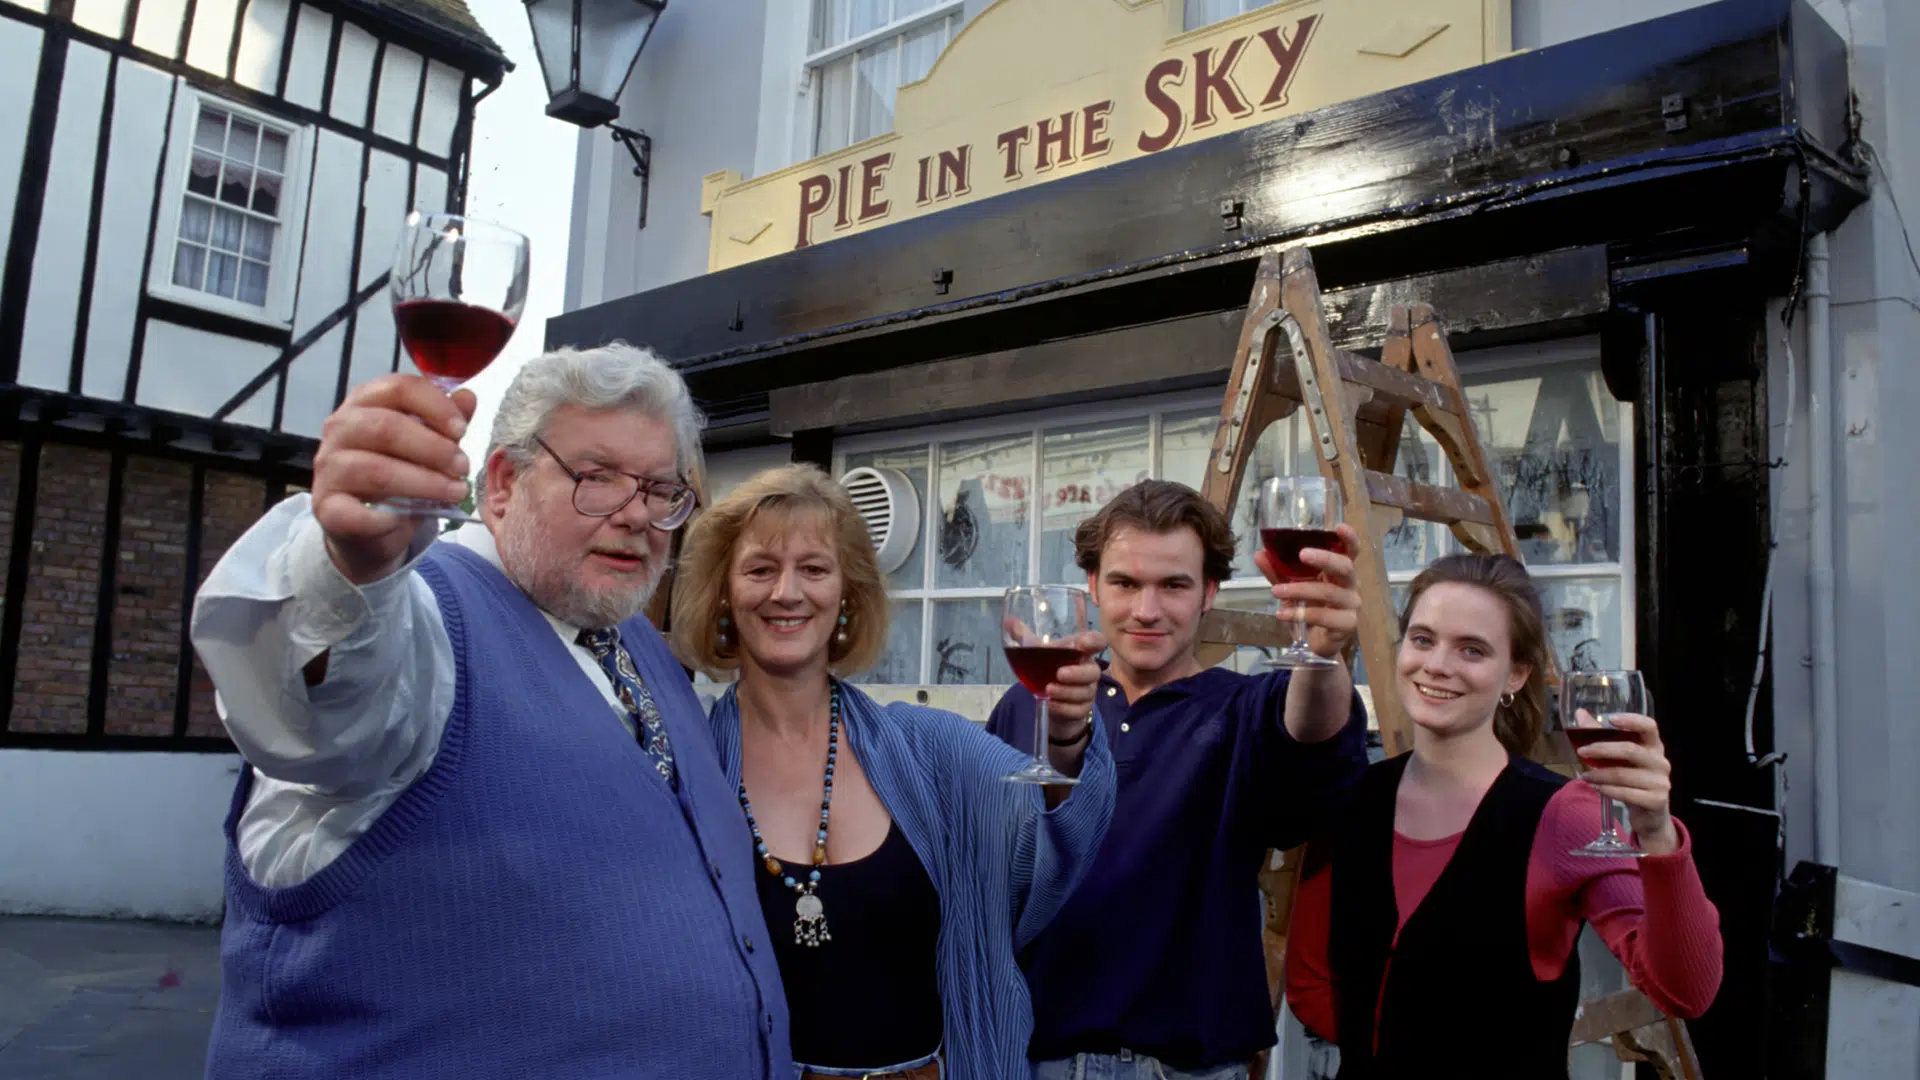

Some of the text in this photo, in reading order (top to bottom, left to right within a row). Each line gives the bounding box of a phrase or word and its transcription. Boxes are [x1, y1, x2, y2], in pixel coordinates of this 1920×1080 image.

[794, 13, 1323, 249] PIE IN THE SKY
